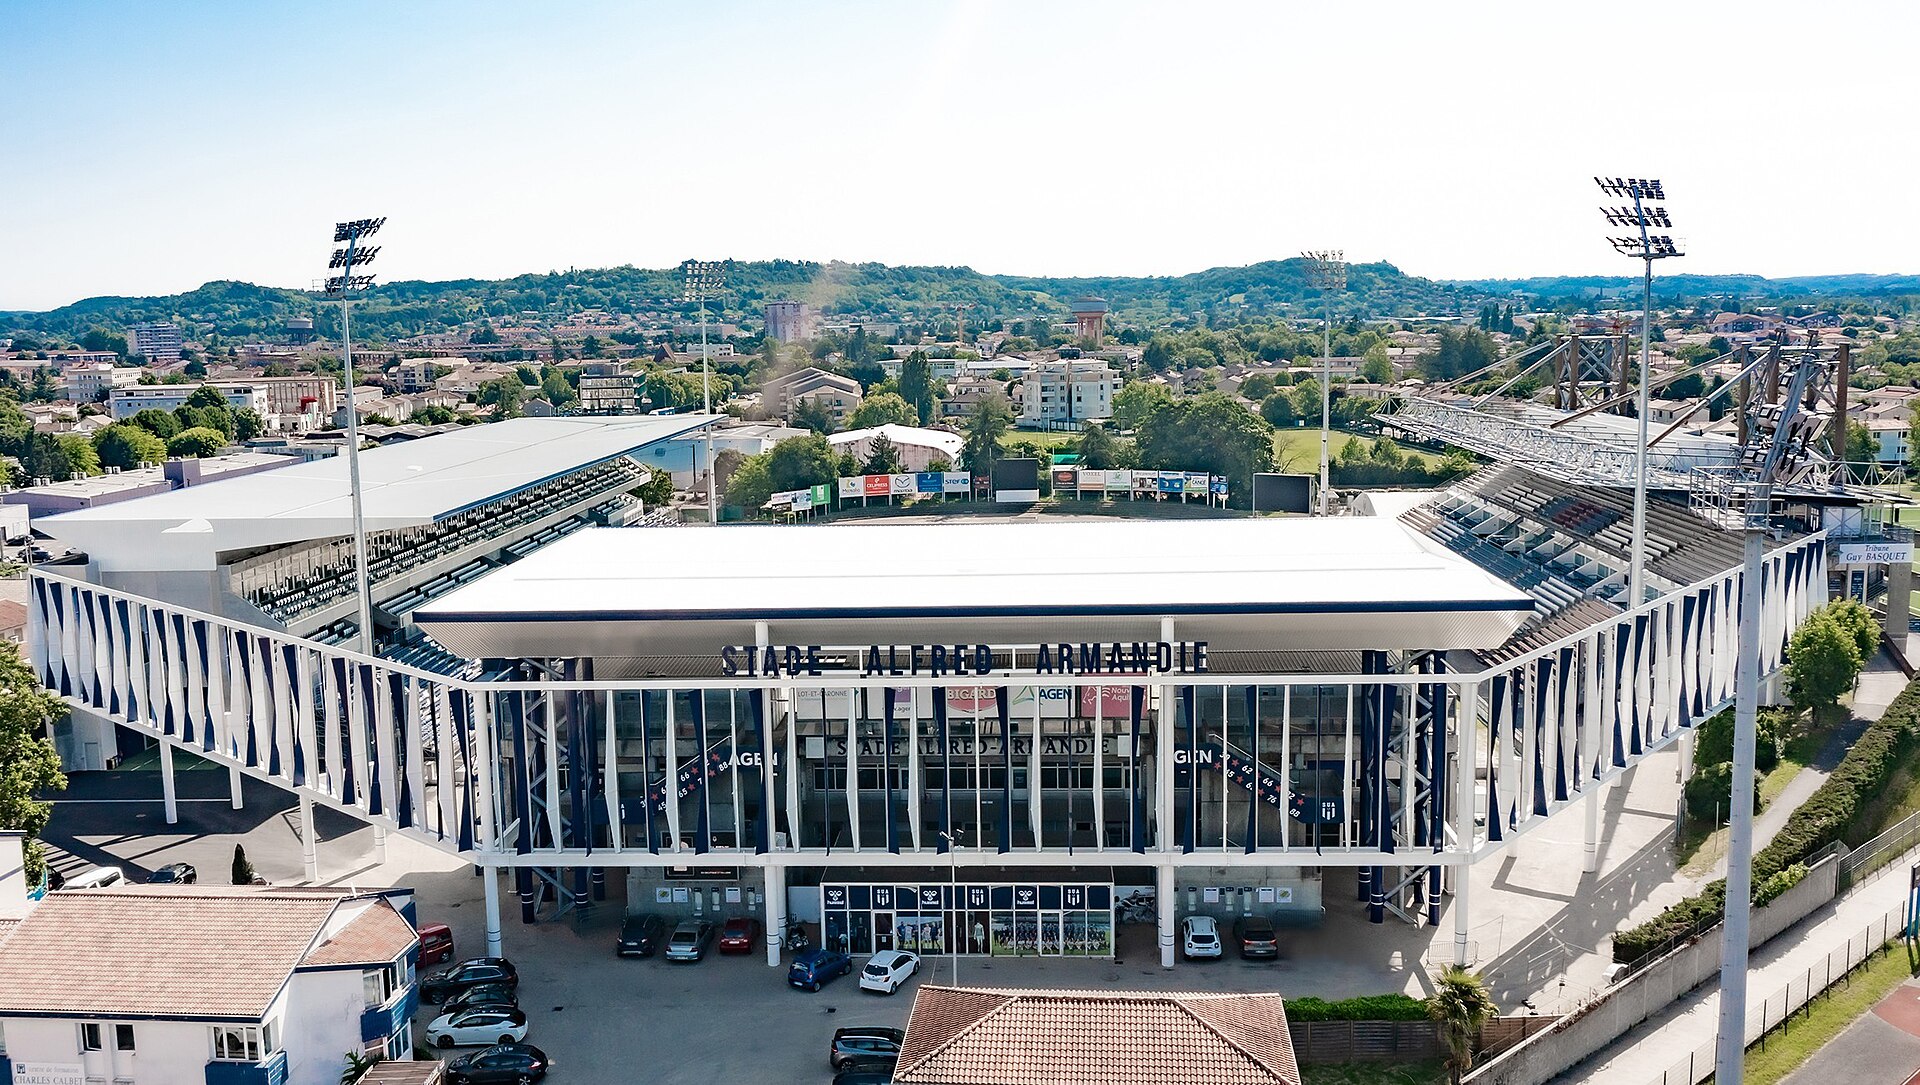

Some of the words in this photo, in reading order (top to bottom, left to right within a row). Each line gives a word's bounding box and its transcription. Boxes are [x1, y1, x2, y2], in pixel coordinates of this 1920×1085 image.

[1846, 553, 1862, 562] Guy
[1866, 552, 1907, 562] BASQUET
[722, 645, 822, 677] STADE
[866, 644, 992, 676] ALFRED
[1036, 641, 1208, 674] ARMANDIE
[947, 689, 996, 700] BIGARD
[1039, 689, 1072, 700] AGEN
[837, 740, 900, 755] SADE
[718, 761, 729, 772] 88
[1241, 765, 1254, 775] 62
[680, 771, 690, 782] 66
[1262, 777, 1274, 787] 66
[678, 787, 688, 798] 65
[1266, 794, 1278, 804] 76
[1289, 808, 1301, 818] 88
[14, 1075, 50, 1085] CHARLES
[53, 1077, 83, 1085] CALBET
